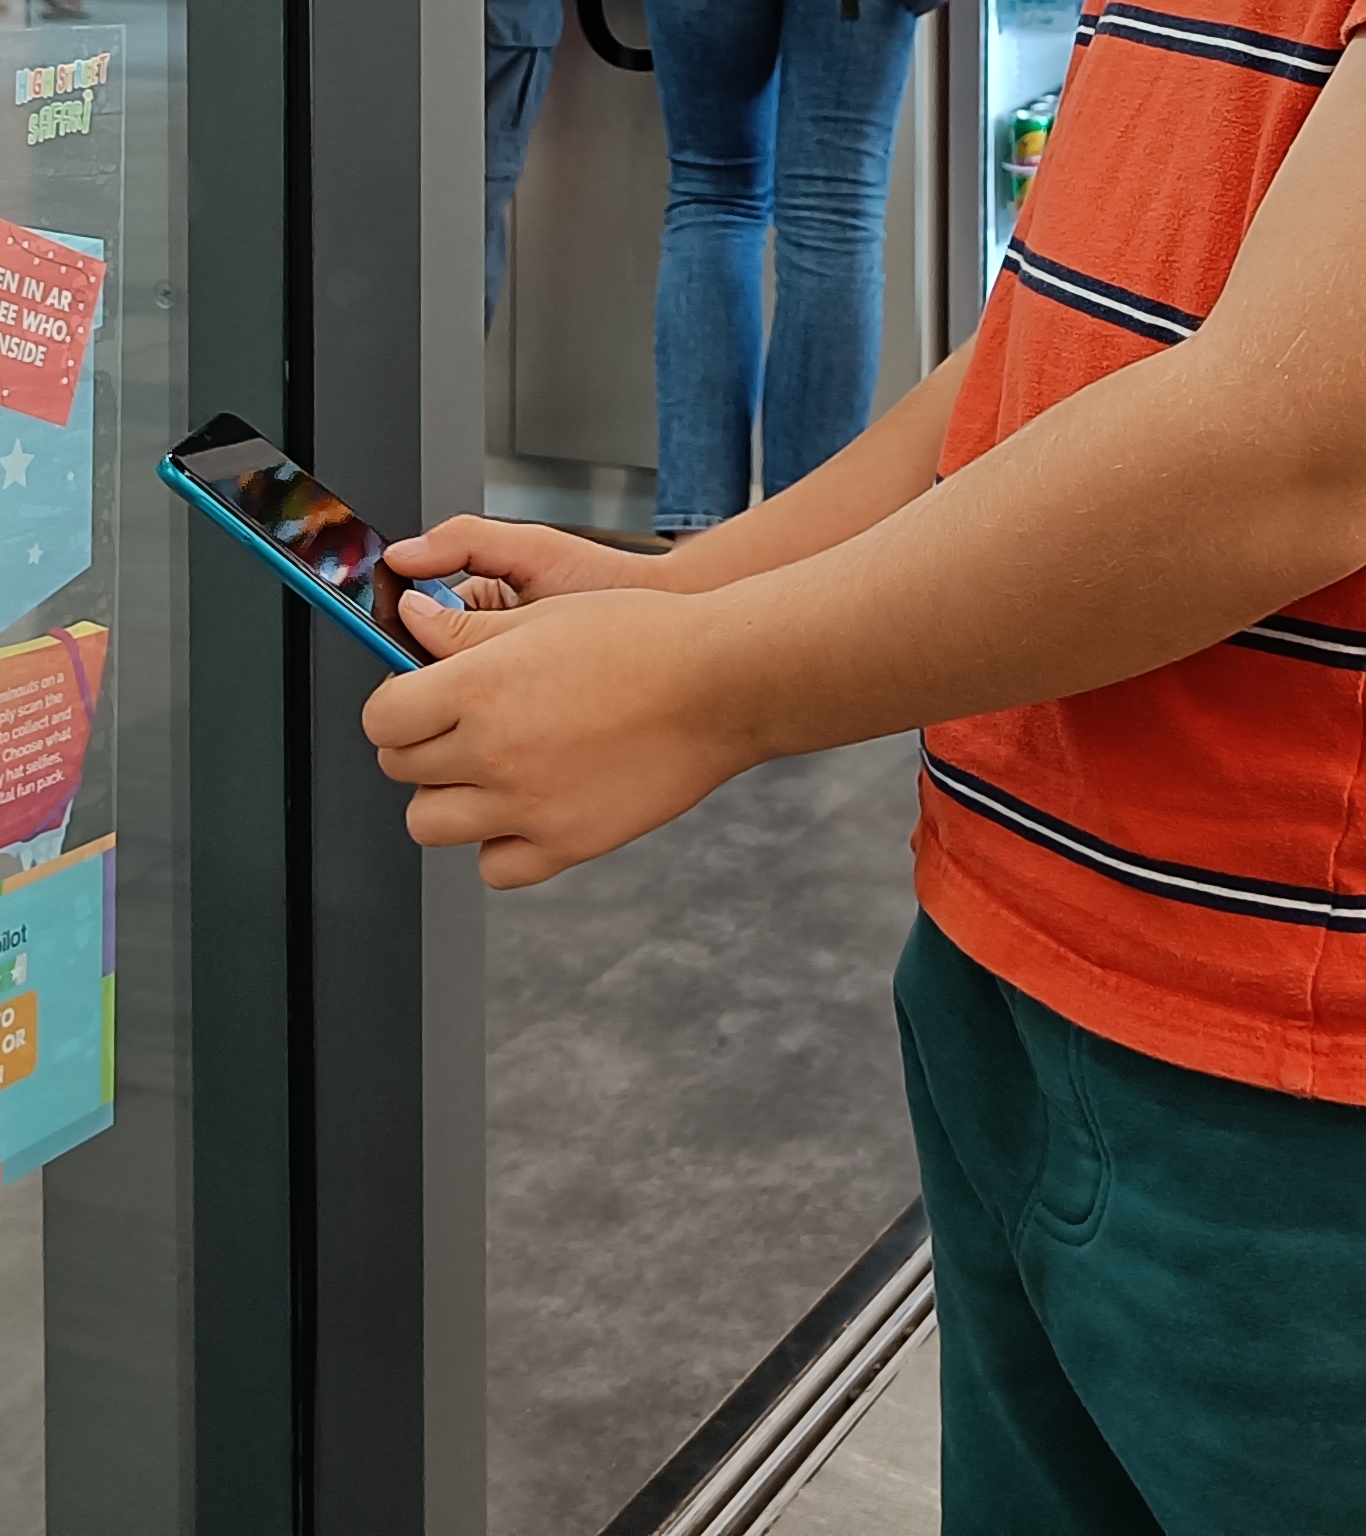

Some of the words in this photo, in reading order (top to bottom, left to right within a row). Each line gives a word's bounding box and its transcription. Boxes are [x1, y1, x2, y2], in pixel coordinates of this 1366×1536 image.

[21, 276, 45, 303] IN
[45, 286, 72, 312] AR
[22, 307, 68, 342] WHO
[41, 675, 56, 689] on
[56, 672, 65, 684] a
[18, 700, 44, 718] scan
[45, 692, 64, 708] the
[51, 706, 72, 726] and
[2, 739, 44, 762] Choose
[45, 726, 72, 747] what
[5, 764, 25, 781] hat
[17, 781, 36, 798] fun
[1, 1027, 27, 1054] OR
